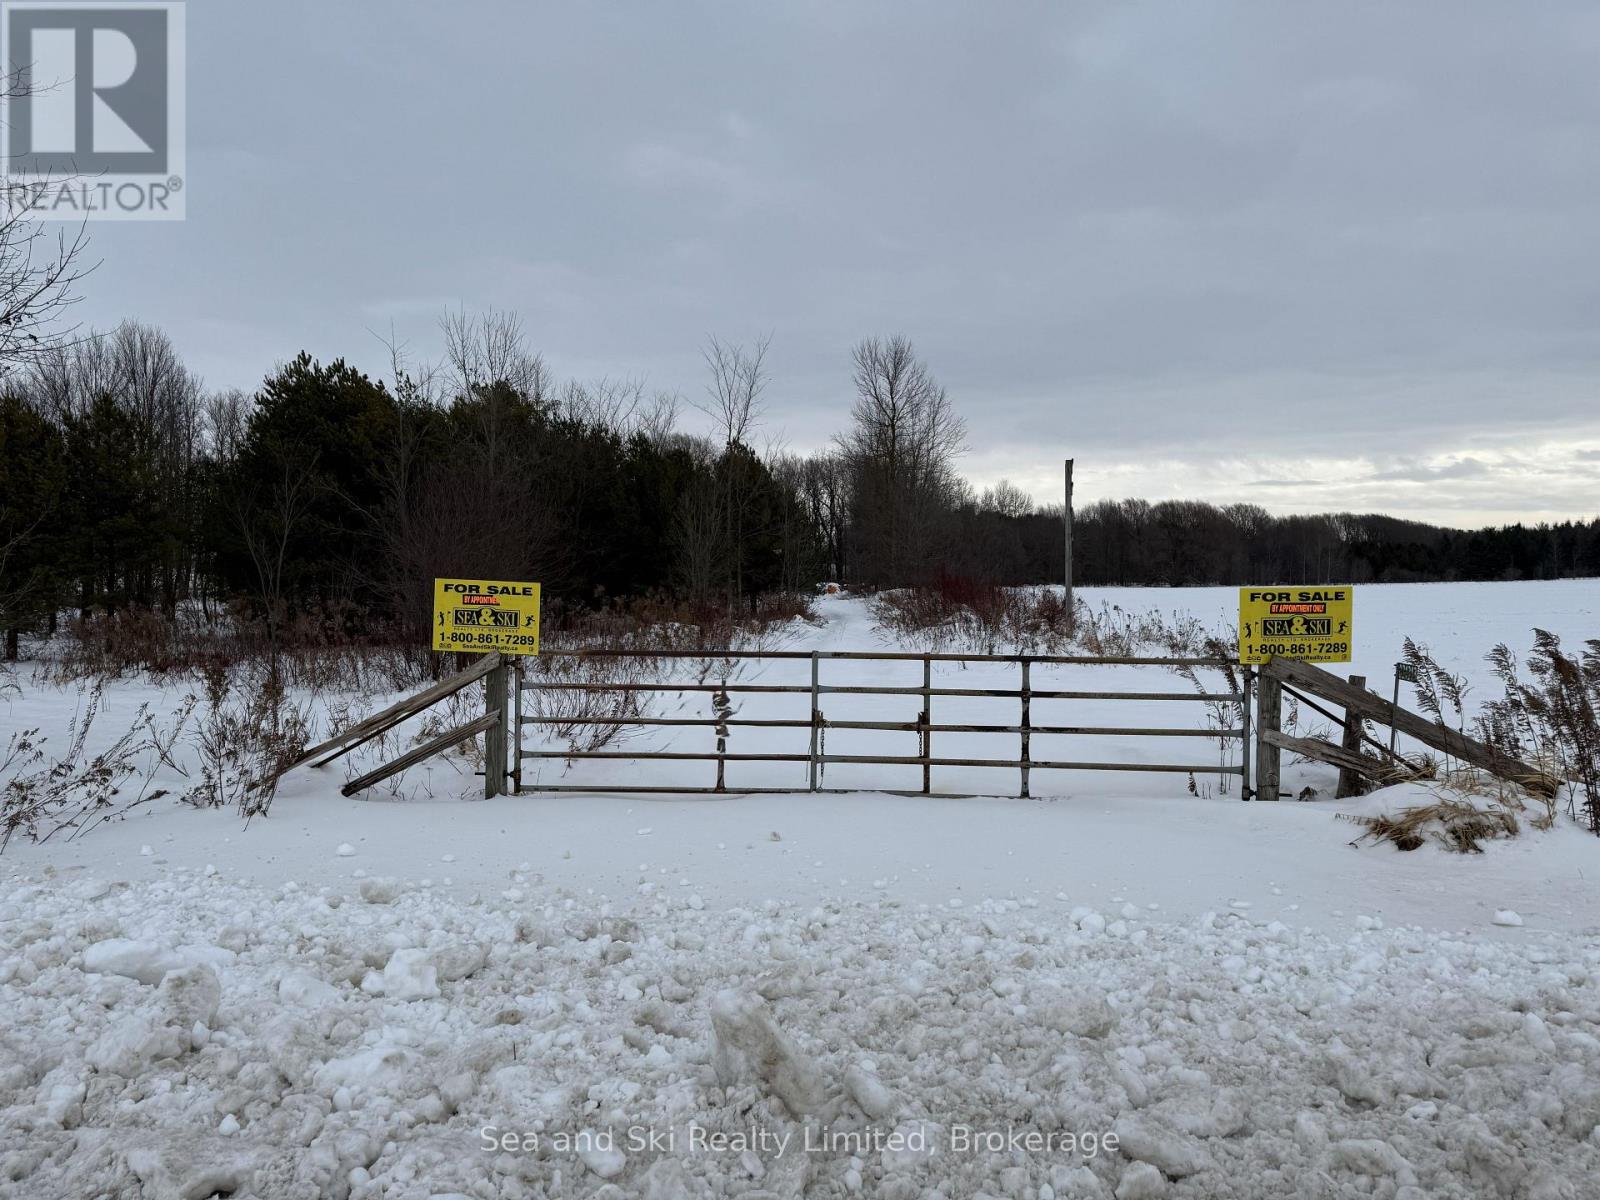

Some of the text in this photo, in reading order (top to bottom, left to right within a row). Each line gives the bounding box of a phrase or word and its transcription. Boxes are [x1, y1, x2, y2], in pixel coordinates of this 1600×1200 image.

[444, 584, 533, 596] FOR SALE
[464, 595, 471, 604] BY
[1250, 591, 1345, 602] FOR SALE
[1271, 604, 1325, 613] BY APPOINTMENT ONLY
[457, 607, 516, 627] SEA & SKI
[1266, 616, 1328, 635] SEA & SKI
[439, 632, 535, 646] 1-800-861-7289
[1247, 643, 1348, 655] 1-800-861-7289
